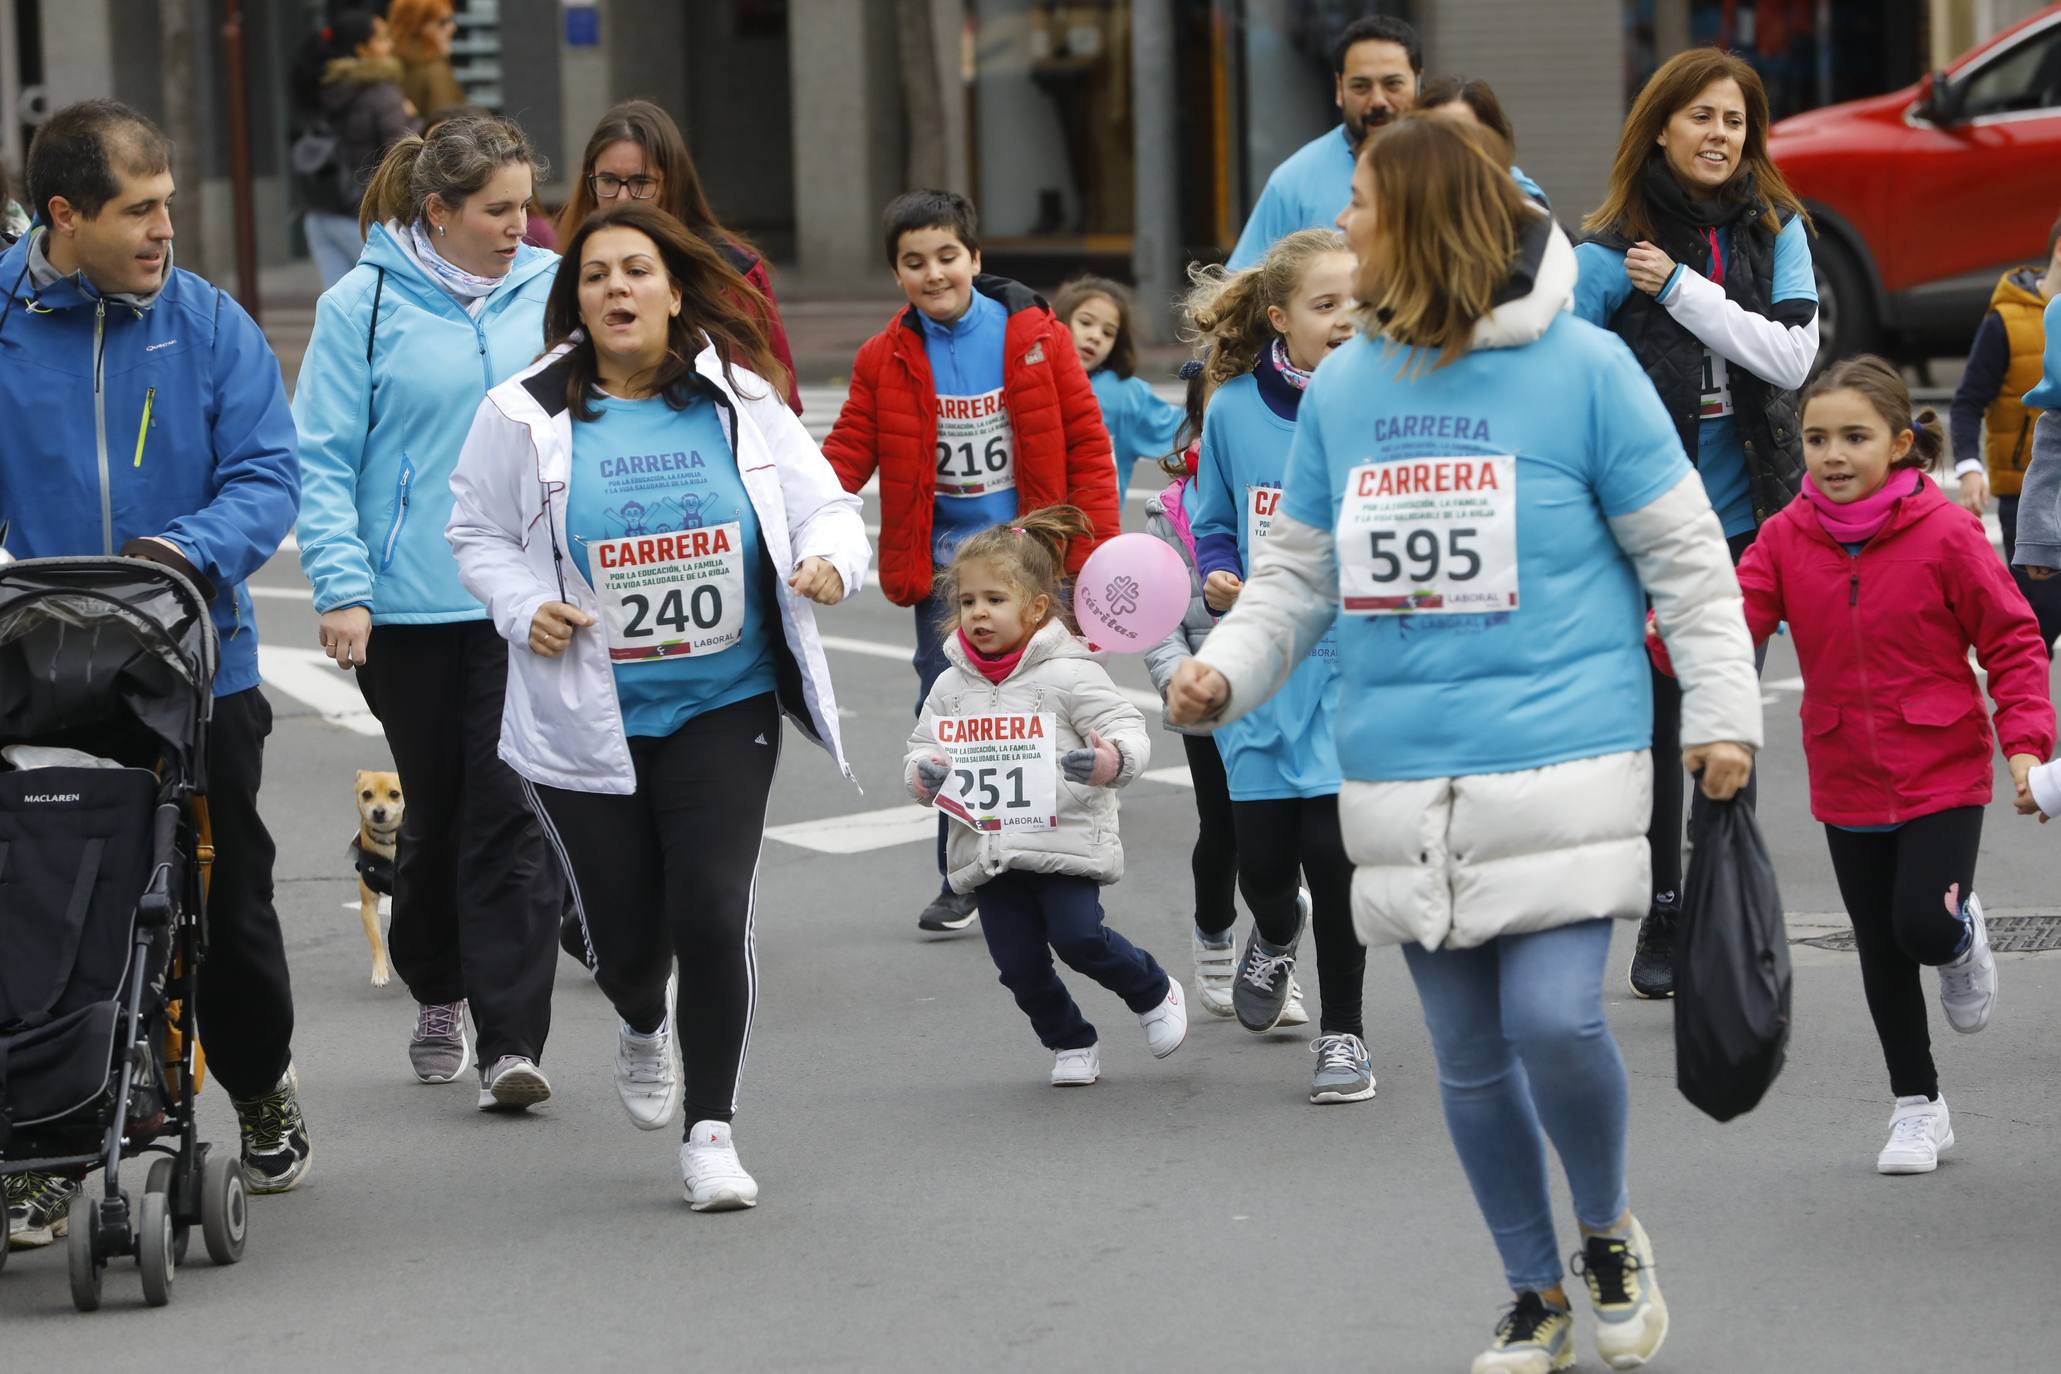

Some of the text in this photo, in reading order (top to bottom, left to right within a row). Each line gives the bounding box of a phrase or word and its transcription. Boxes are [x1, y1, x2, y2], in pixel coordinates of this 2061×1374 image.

[936, 391, 1006, 419] ARRERA
[1375, 415, 1490, 442] CARRERA
[600, 450, 706, 478] CARRERA
[936, 436, 1008, 477] 216
[986, 475, 1015, 488] LABORA
[1358, 462, 1499, 497] CARRERA
[599, 528, 730, 569] CARRERA
[1370, 528, 1482, 582] 595
[605, 567, 730, 590] Y LA VIDA SALUDABLE DE LA RIOJA
[609, 573, 625, 581] POR
[627, 571, 636, 579] LA
[638, 564, 681, 577] EDUCACIÓN,
[694, 559, 723, 569] FAMILIA
[1447, 592, 1498, 603] LABORAL
[620, 584, 723, 639] 240
[1081, 586, 1138, 639] Cáritas
[694, 632, 735, 648] LABORAL
[938, 715, 1044, 743] CARRERA
[967, 744, 998, 754] EDUCACIÓN,
[1009, 743, 1036, 752] FAMILIA
[970, 755, 1000, 763] SALUDABLE
[24, 793, 80, 802] MACLAREN
[954, 767, 1031, 810] 251
[1004, 815, 1044, 825] LABORAL
